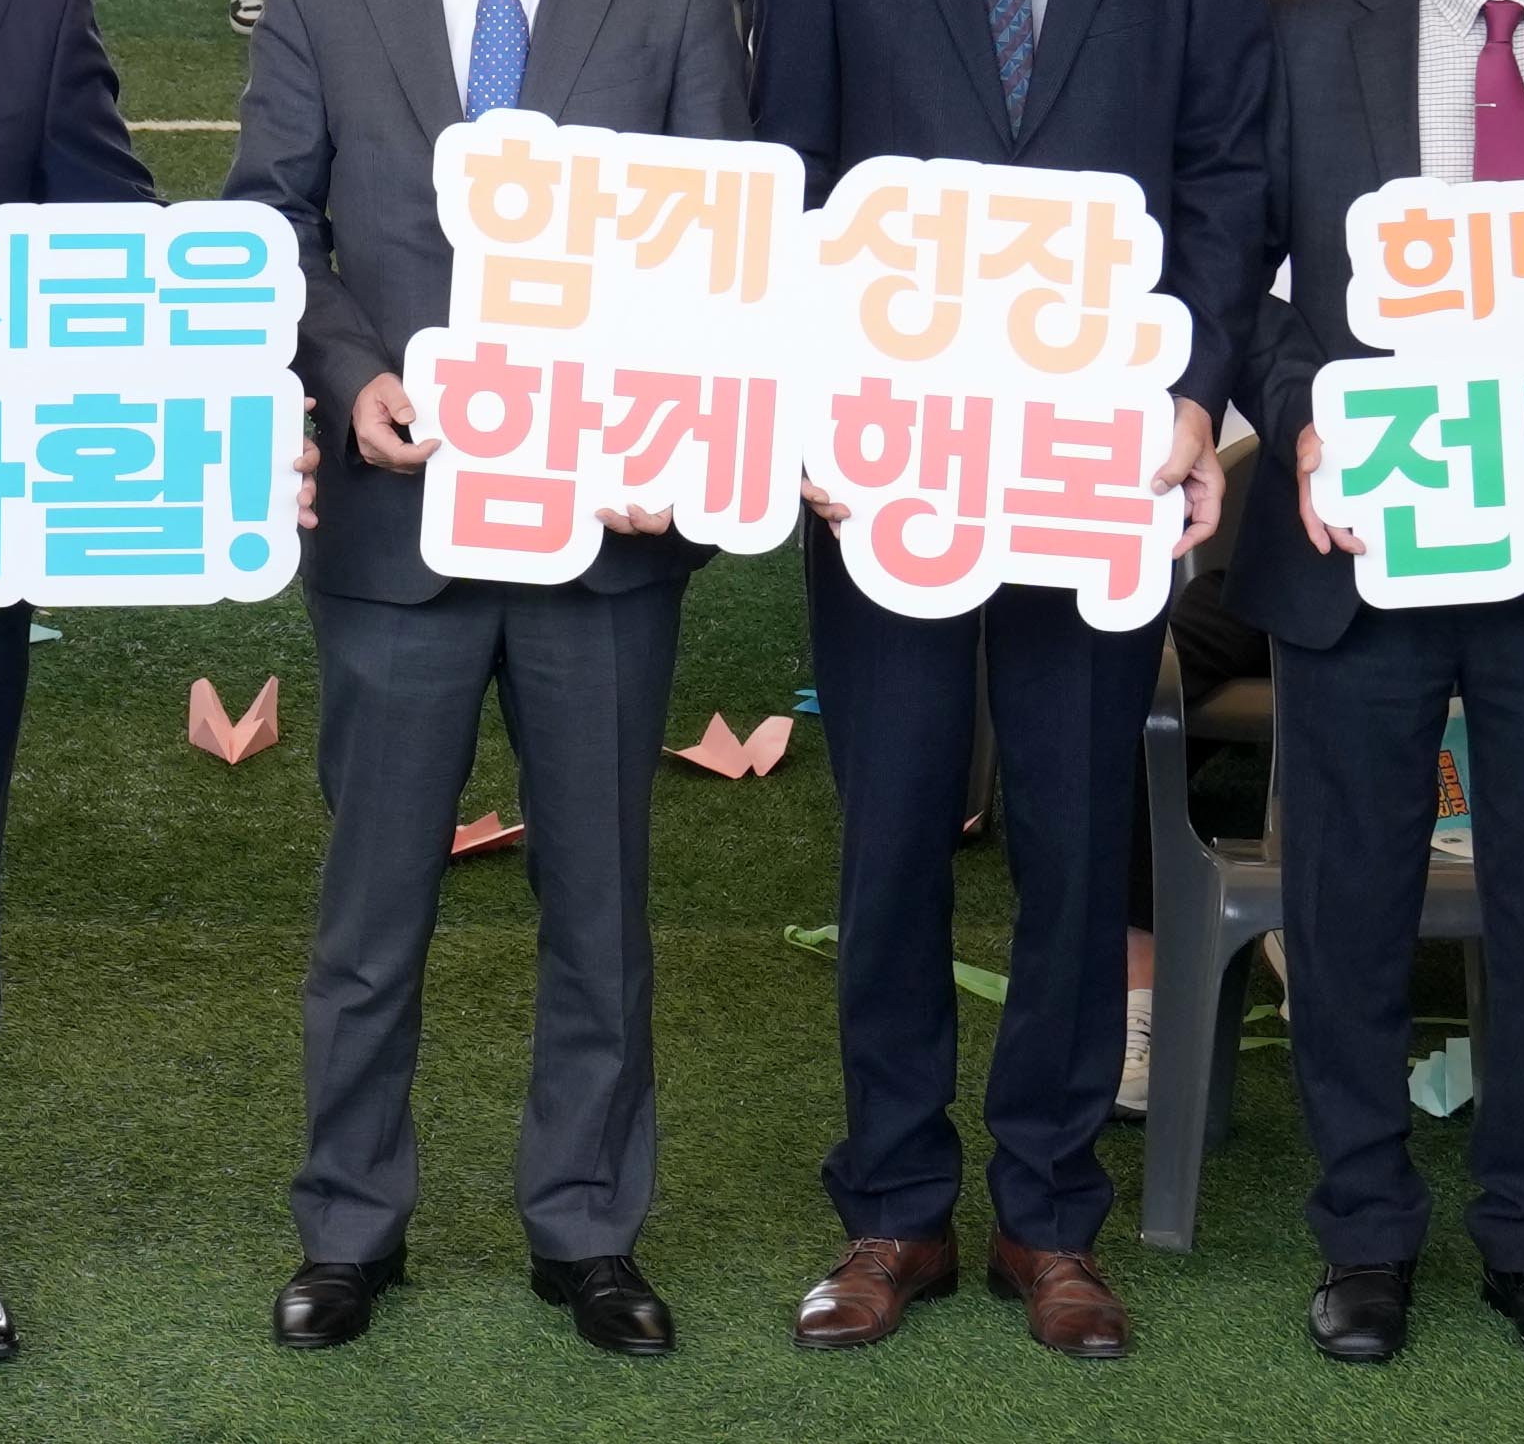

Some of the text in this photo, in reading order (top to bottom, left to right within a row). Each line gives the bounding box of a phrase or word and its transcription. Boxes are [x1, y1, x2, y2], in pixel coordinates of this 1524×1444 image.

[463, 139, 1162, 375] 함께 성장,
[434, 342, 1154, 602] 함께 행복
